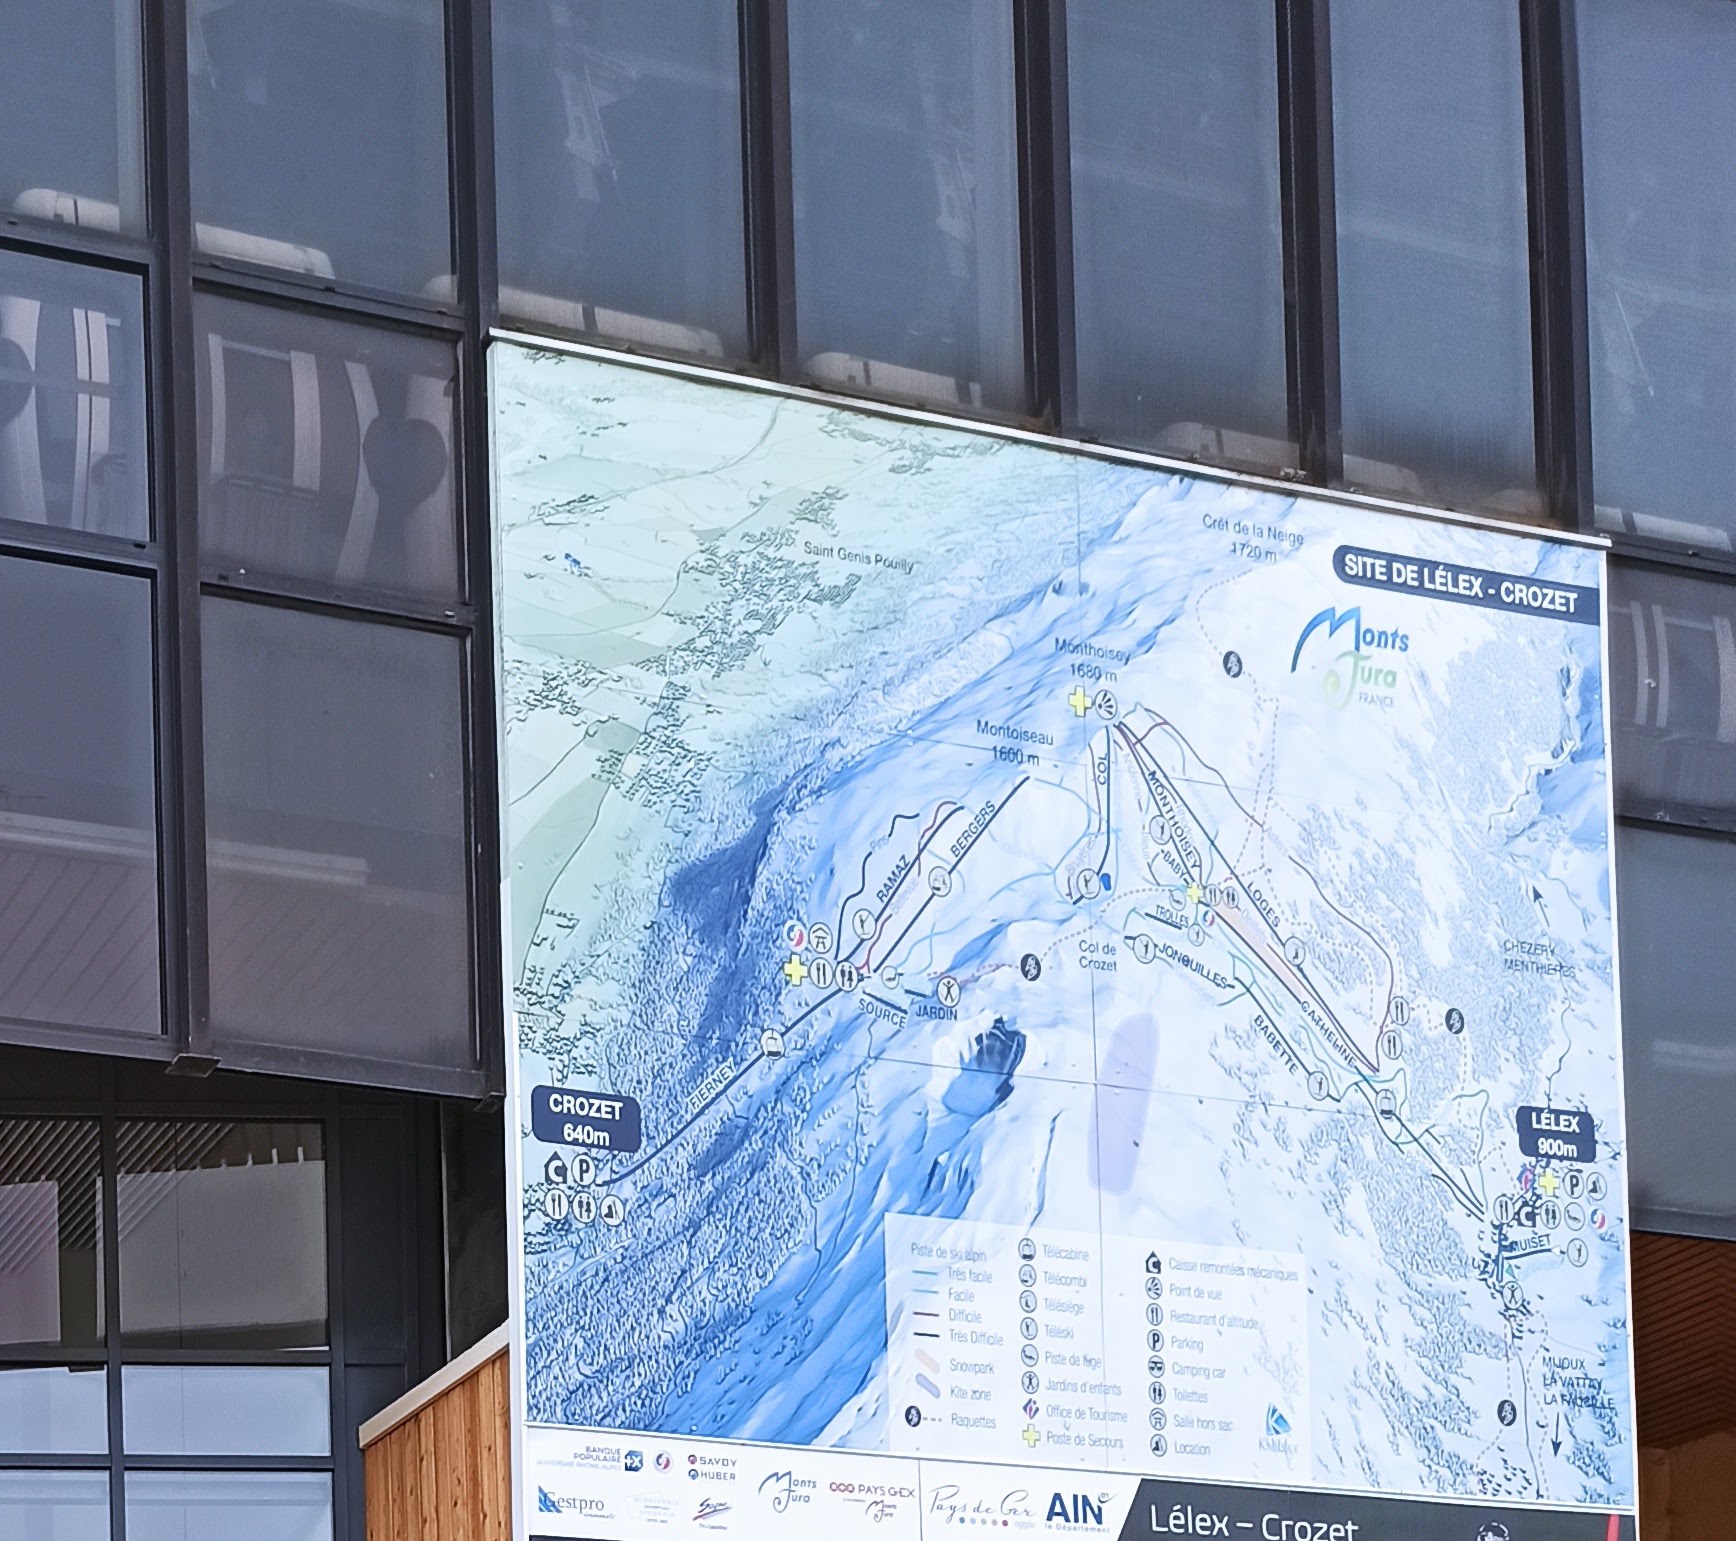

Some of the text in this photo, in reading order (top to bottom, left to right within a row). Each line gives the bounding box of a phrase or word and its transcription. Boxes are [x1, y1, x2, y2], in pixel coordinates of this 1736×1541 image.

[1202, 513, 1304, 546] Crêt de la Neige
[804, 540, 915, 575] Saint Genis Pouilly
[1264, 550, 1277, 563] m
[1344, 553, 1578, 614] SITE DE LÉLEX CROZET
[1291, 606, 1409, 673] Monts
[1054, 637, 1131, 667] Monthoisey
[1070, 663, 1117, 682] 1680 m
[1323, 650, 1398, 710] Jura
[976, 720, 1054, 747] Montoiseau
[1027, 752, 1040, 766] m
[1097, 752, 1108, 786] COL
[1147, 770, 1200, 870] MONTHOISEY
[950, 800, 997, 858] BERGERS
[876, 854, 911, 903] RAMAZ
[1247, 881, 1281, 928] LOGES
[1155, 904, 1190, 928] TROLLES
[1079, 940, 1116, 956] Col de
[1079, 957, 1117, 972] Crozet
[1159, 942, 1229, 989] JONQUILLES
[858, 998, 907, 1029] SOURCE
[916, 1004, 959, 1021] JARDIN
[1254, 1014, 1299, 1075] BABETTE
[689, 1059, 737, 1110] FIERNEY
[549, 1093, 624, 1121] CROZET
[1531, 1109, 1580, 1133] LÉLEX
[563, 1123, 610, 1147] 640m
[1538, 1137, 1578, 1158] 900m
[911, 1242, 947, 1258] Piste de
[1044, 1244, 1089, 1261] Télécabine
[948, 1268, 992, 1283] Très facile
[1168, 1257, 1298, 1282] Caisse remontées mécaniques
[949, 1288, 975, 1302] Facile
[1170, 1284, 1223, 1300] Point de vue
[949, 1308, 982, 1324] Difficile
[1170, 1310, 1217, 1326] Restaurant
[950, 1329, 1003, 1346] Très Difficile
[1045, 1324, 1074, 1339] Téléski
[1171, 1336, 1203, 1353] Parking
[950, 1358, 995, 1375] Snowpark
[1045, 1351, 1081, 1367] Piste de
[1172, 1362, 1226, 1380] Camping car
[950, 1385, 991, 1401] Kite zone
[1045, 1379, 1078, 1393] Jardins
[1173, 1389, 1208, 1403] Toilettes
[951, 1413, 996, 1429] Raquettes
[1046, 1404, 1128, 1422] Office de Tourisme
[1173, 1415, 1233, 1432] Salle hors sac
[1047, 1431, 1124, 1449] Poste de Secours
[1174, 1441, 1210, 1456] Location
[573, 1453, 621, 1463] POPULAIRE
[585, 1446, 621, 1455] BANQUE
[700, 1456, 737, 1467] SAVOY
[700, 1471, 736, 1481] HUBER
[858, 1484, 886, 1497] PAYS
[1046, 1493, 1104, 1525] AIN
[1150, 1504, 1230, 1537] Lélex
